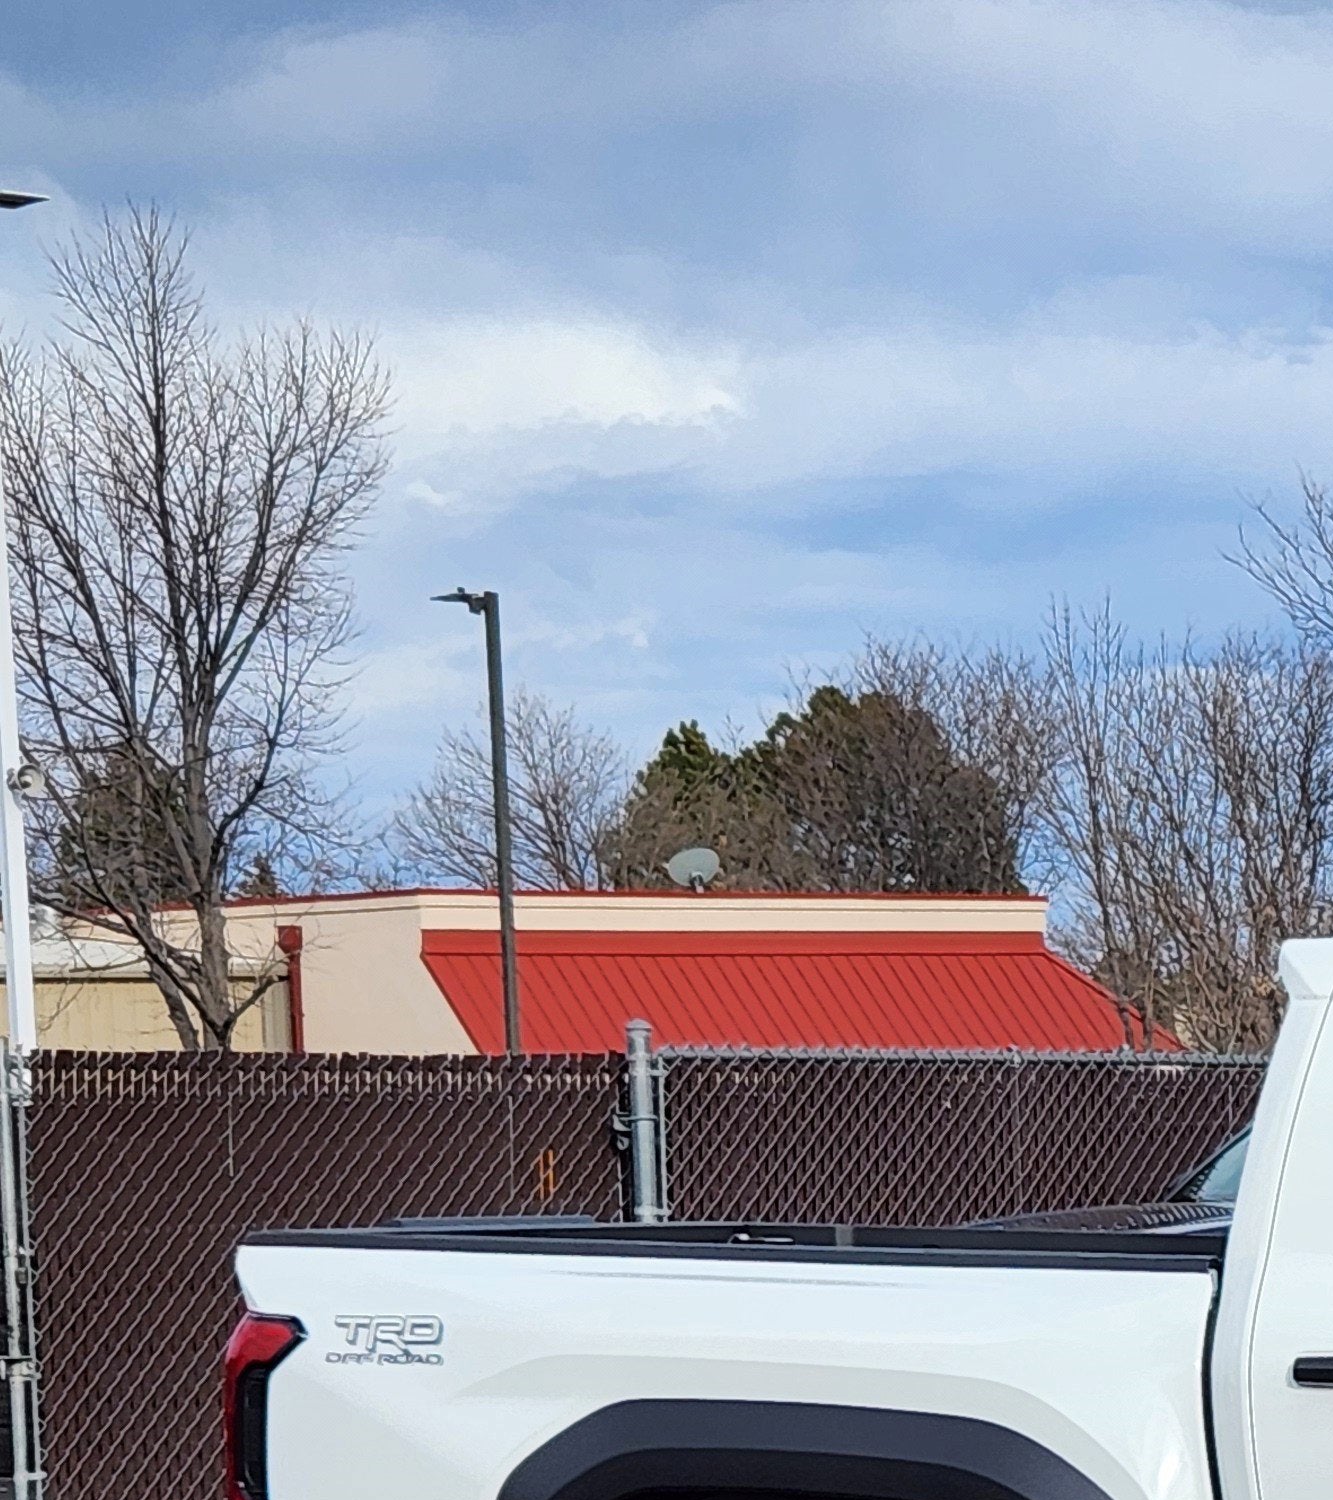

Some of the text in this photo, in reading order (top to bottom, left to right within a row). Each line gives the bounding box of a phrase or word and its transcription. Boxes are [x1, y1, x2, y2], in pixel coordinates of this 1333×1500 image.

[333, 1314, 444, 1354] TRD
[325, 1352, 444, 1366] OFF ROAD
